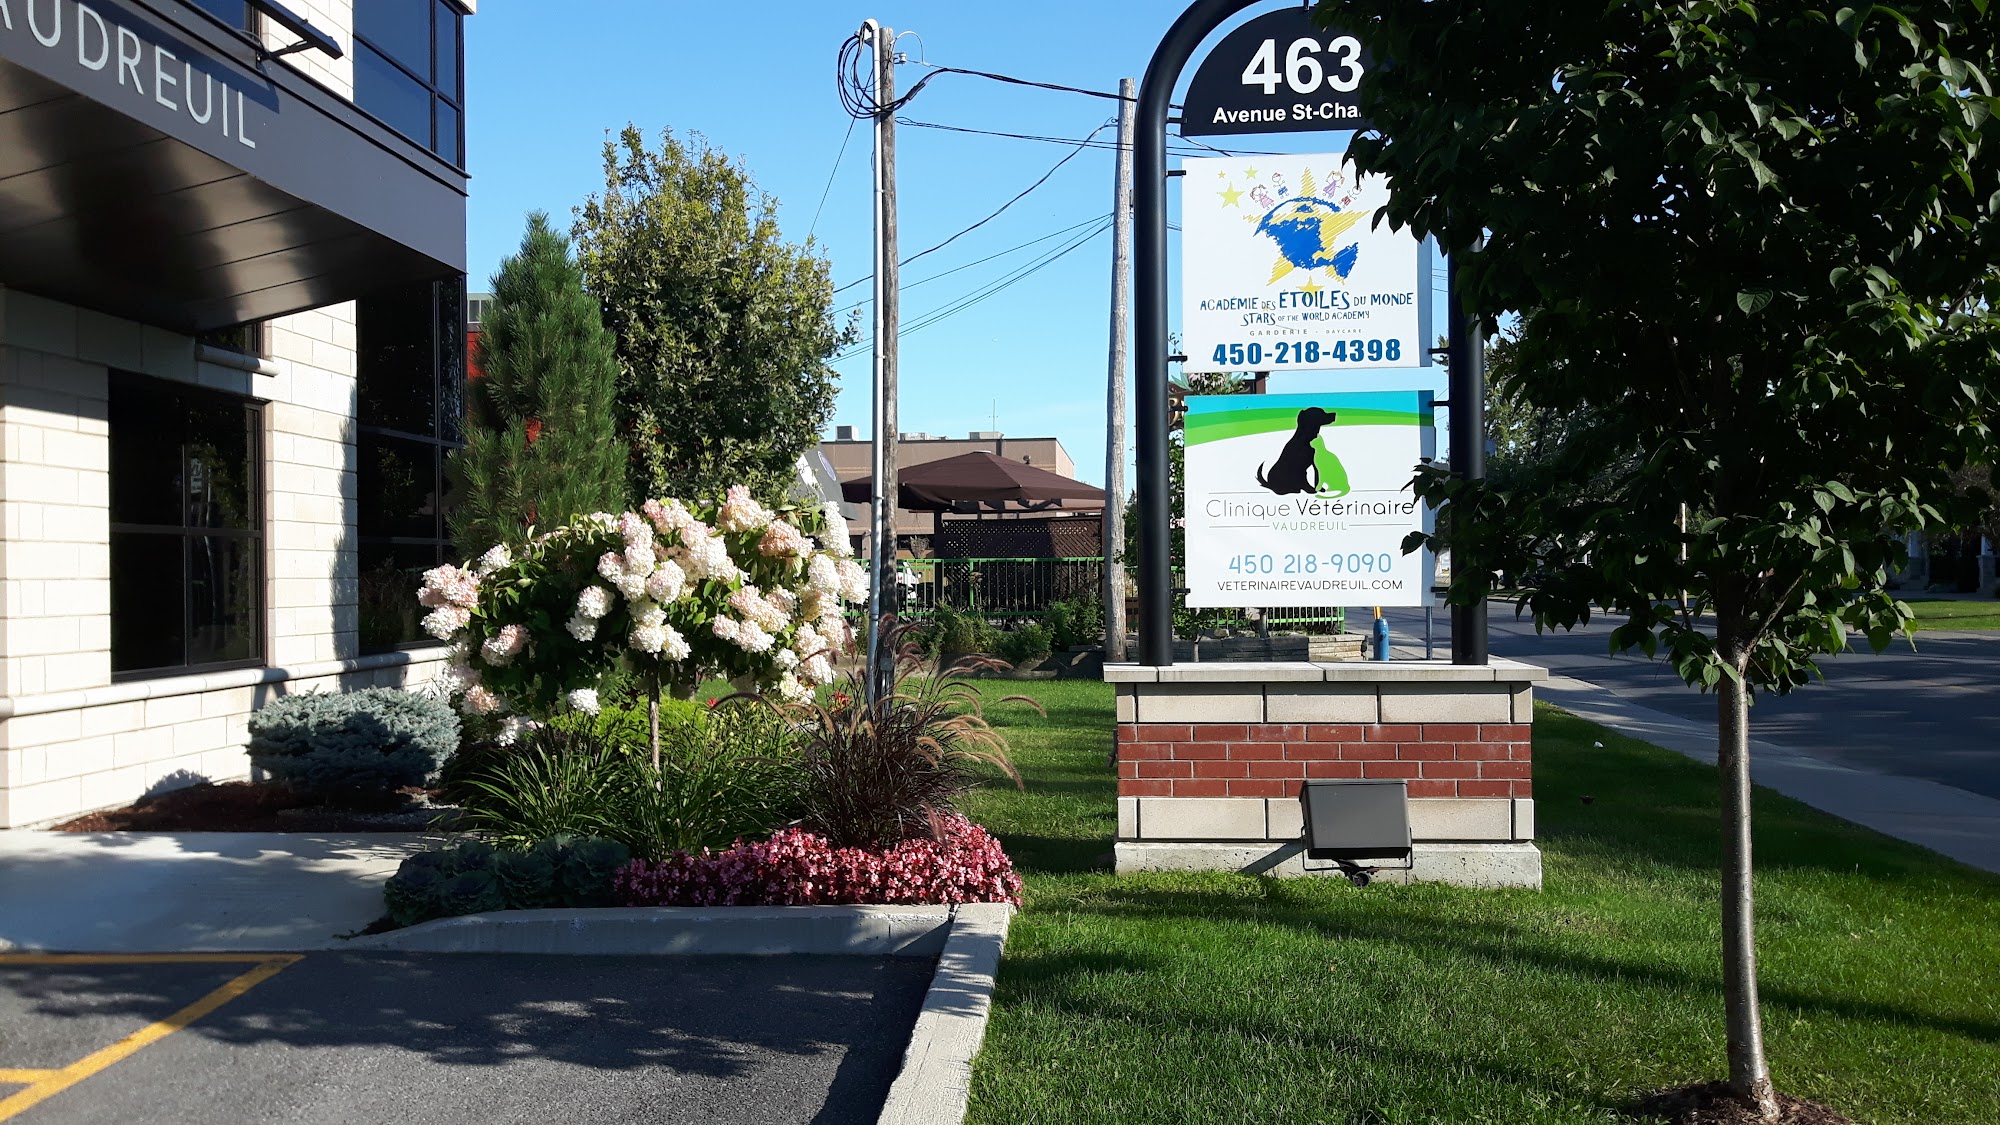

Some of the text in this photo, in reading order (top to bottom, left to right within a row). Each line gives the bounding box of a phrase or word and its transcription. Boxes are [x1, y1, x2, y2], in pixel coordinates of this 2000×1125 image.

[1241, 35, 1365, 95] 463
[1212, 101, 1362, 125] Avenue St-Cha
[1200, 289, 1414, 311] ACADÉMIE DES ÉTOILES DU MONDE
[1240, 312, 1276, 326] STARS
[1287, 314, 1300, 322] THE
[1302, 311, 1330, 322] WORLD
[1331, 310, 1370, 320] ACADEMY
[1212, 338, 1401, 365] 450-218-4398
[1205, 498, 1414, 521] Clinique Vétérinaire
[1272, 521, 1347, 532] VAUDREUIL
[1228, 553, 1392, 575] 450 218-9090
[1217, 579, 1403, 591] VETERINAIREVAUDREUIL.COM
